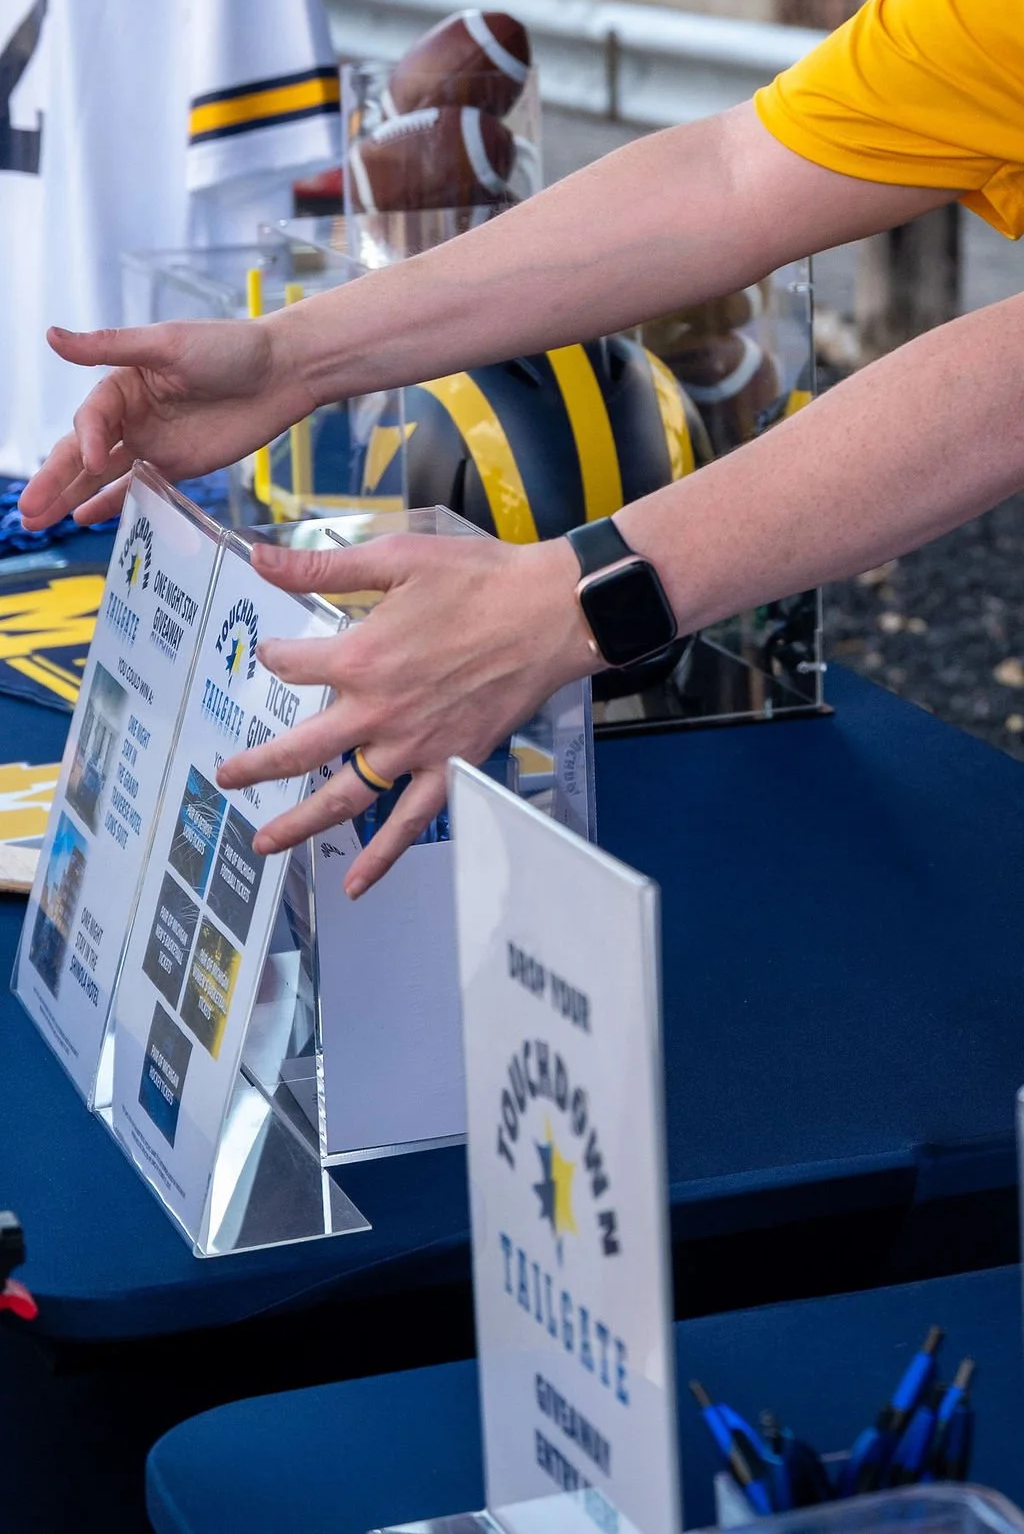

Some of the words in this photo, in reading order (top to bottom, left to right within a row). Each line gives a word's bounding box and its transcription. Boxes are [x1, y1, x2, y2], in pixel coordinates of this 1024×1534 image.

[118, 517, 154, 590] TOUCHDOWN
[106, 593, 140, 639] TAILGATE
[153, 570, 167, 598] ONE
[165, 580, 185, 614] NIGHT
[182, 596, 198, 626] STAY
[152, 607, 184, 651] GIVEAWAY
[215, 598, 258, 680] TOUCHDOWN
[118, 658, 127, 675] YOU
[126, 666, 141, 689] COULD
[140, 680, 149, 698] WIN
[265, 676, 300, 730] TICKET
[128, 715, 138, 736] ONE
[203, 679, 244, 736] TAILGATE
[122, 738, 133, 760] STAY
[225, 844, 234, 861] PAIR
[76, 931, 86, 954] STAY
[81, 907, 91, 929] ONE
[508, 941, 544, 1000] DROP
[497, 1039, 621, 1256] TOUCHDOWN
[500, 1231, 630, 1407] TAILGATE
